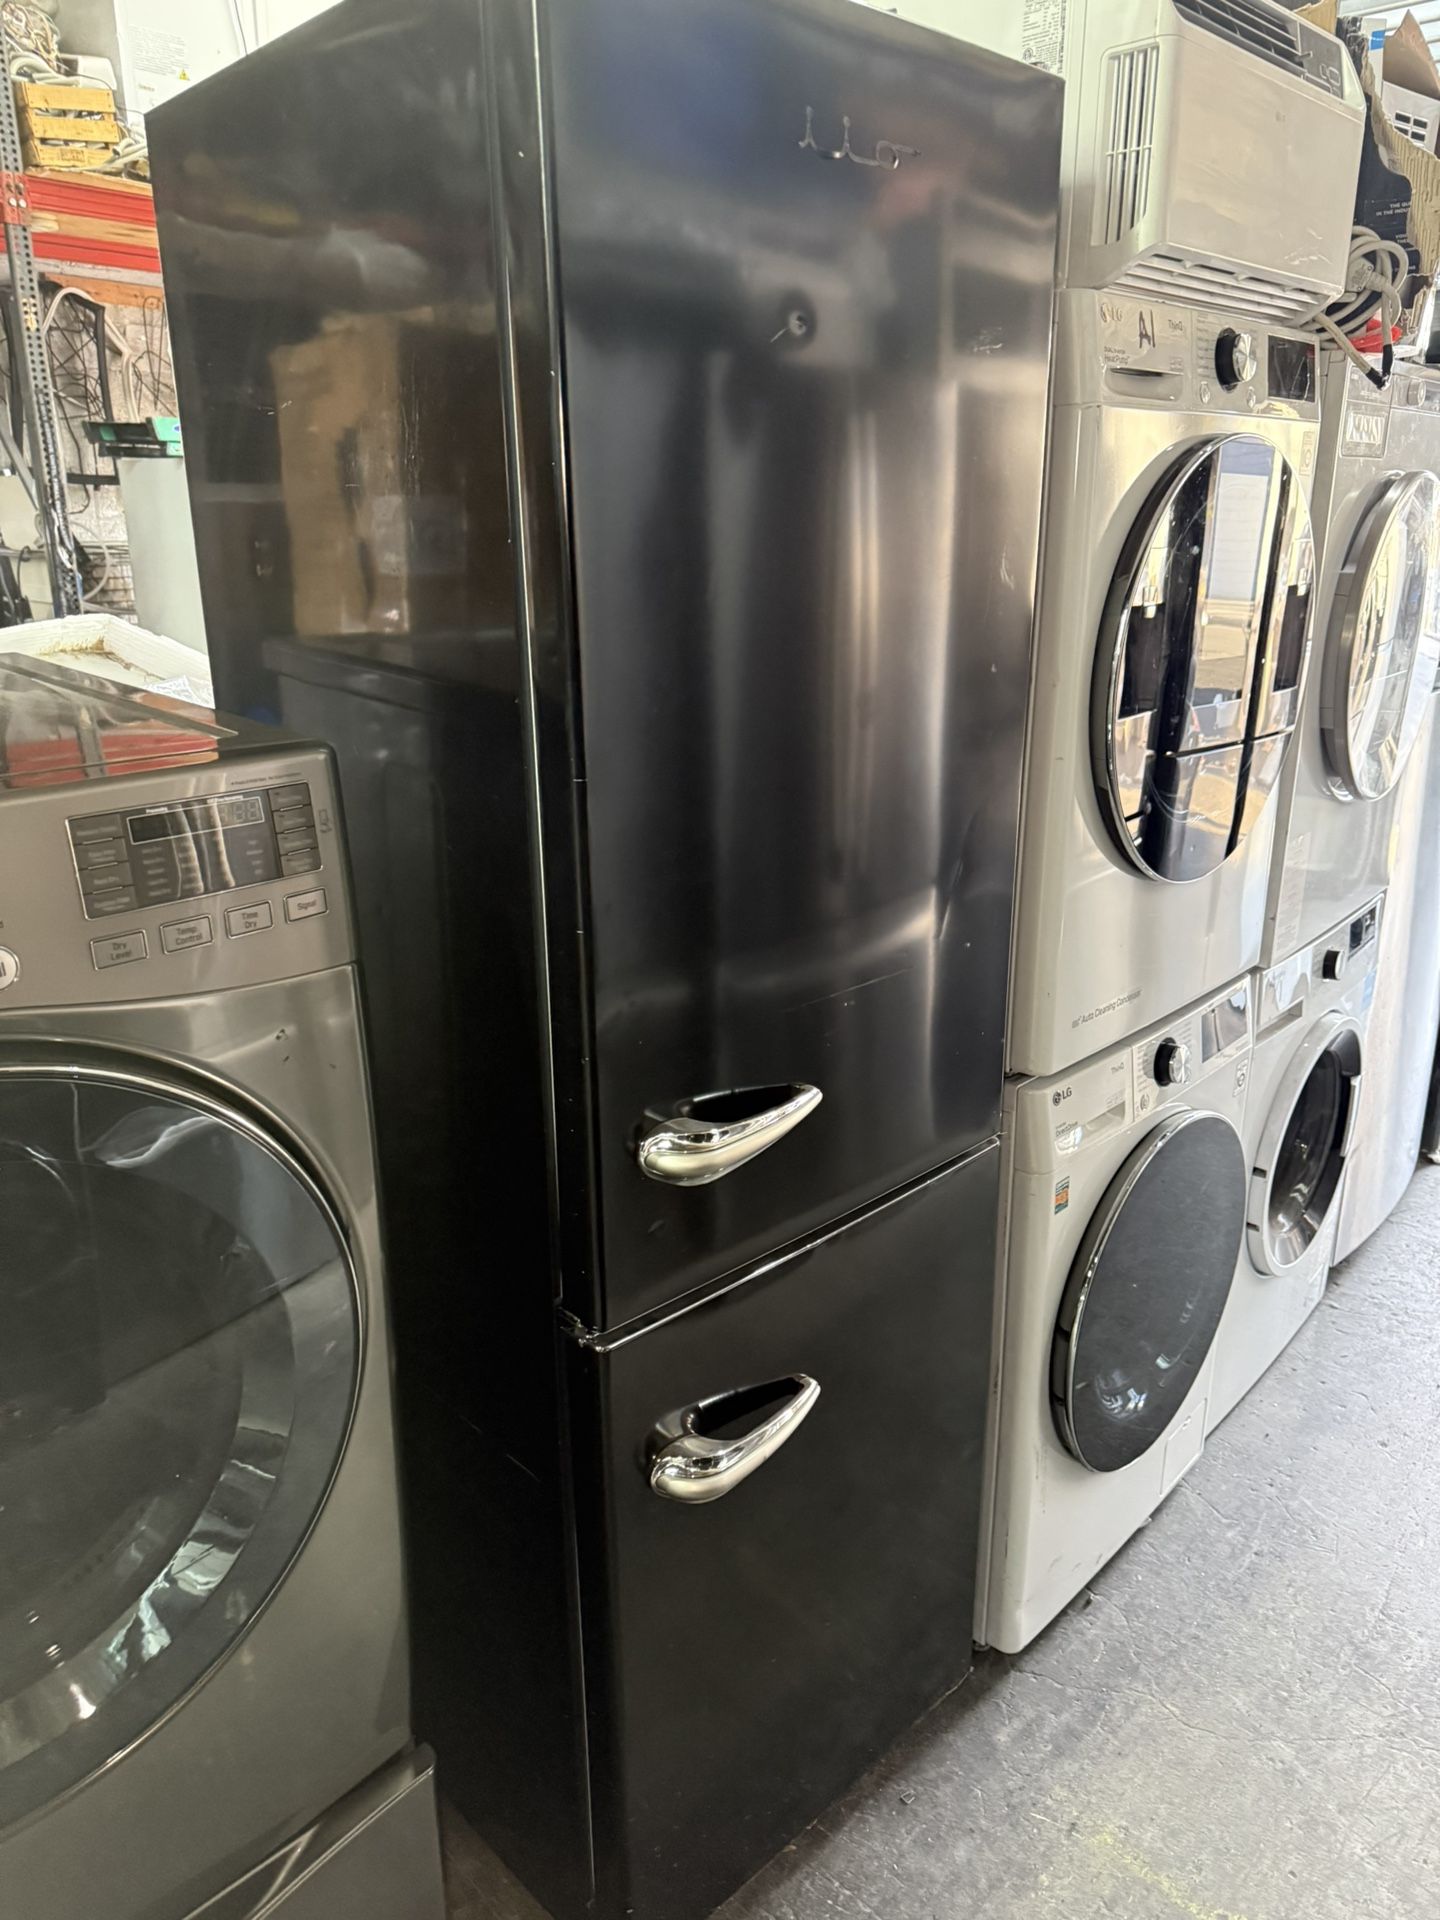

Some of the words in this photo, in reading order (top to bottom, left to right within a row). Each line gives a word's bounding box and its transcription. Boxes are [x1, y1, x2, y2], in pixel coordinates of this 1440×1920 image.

[296, 900, 317, 911] Signal
[244, 920, 257, 929] Dry
[175, 933, 203, 946] Control
[112, 942, 127, 952] Dry
[110, 951, 132, 962] Level
[1094, 1001, 1116, 1018] Cleaning
[1061, 1086, 1073, 1100] LG
